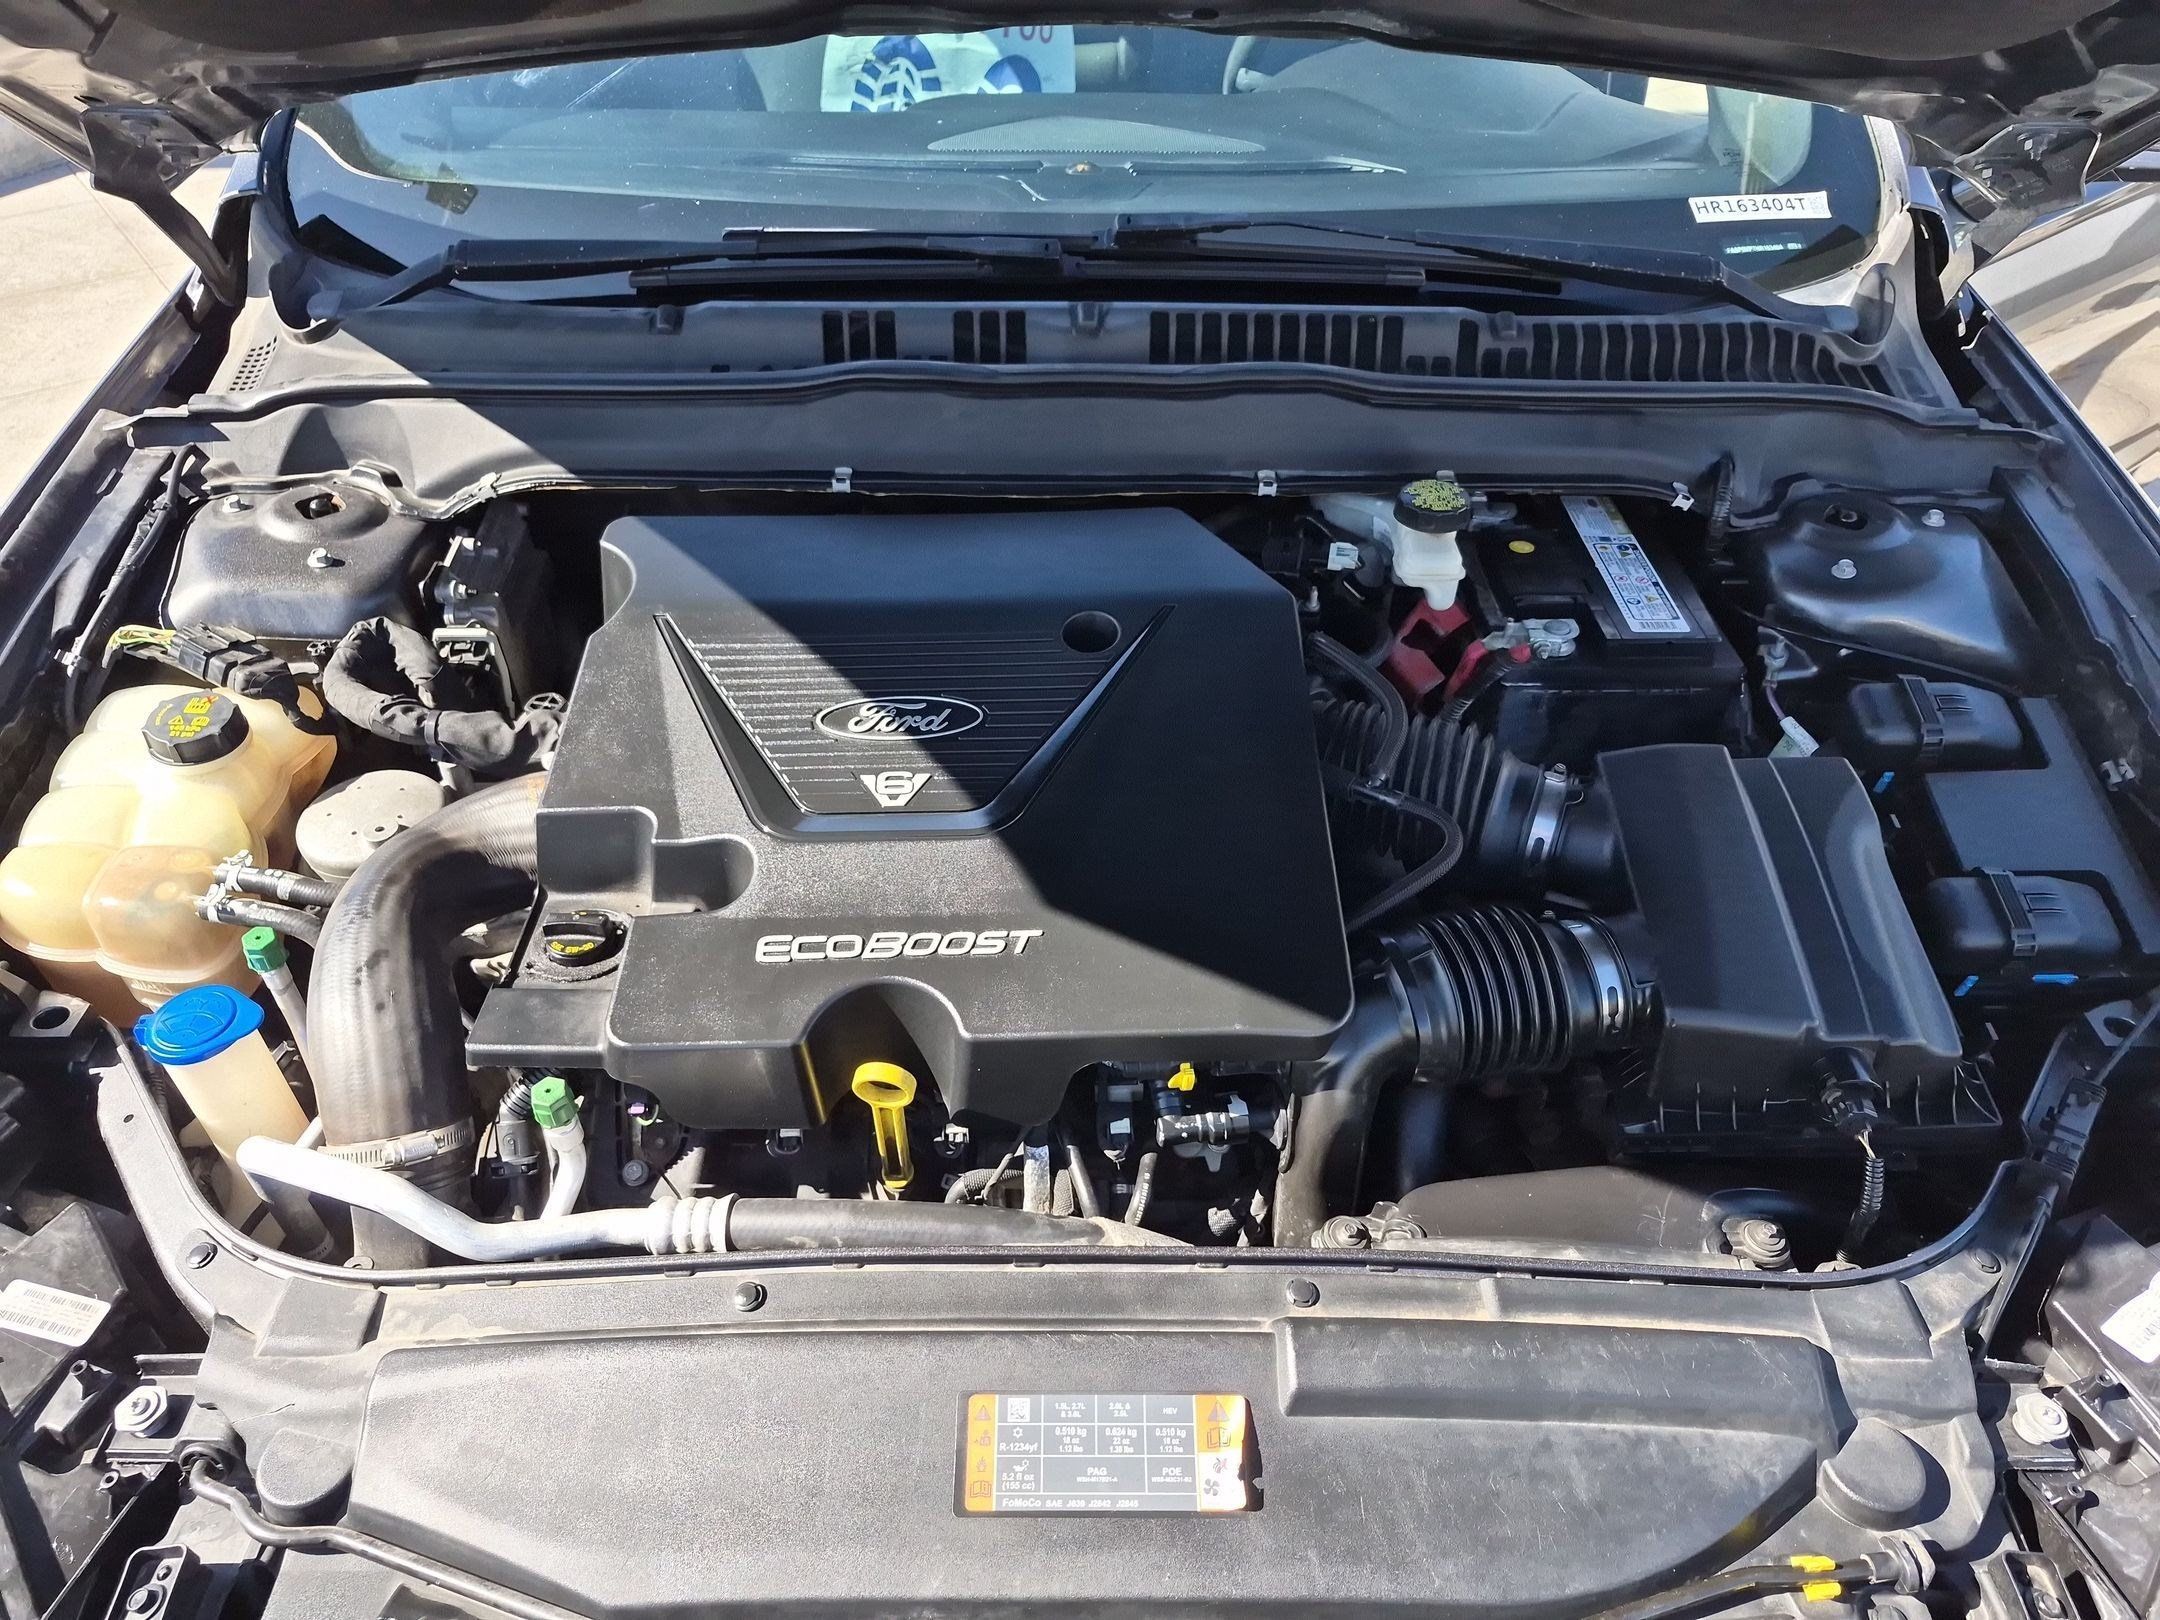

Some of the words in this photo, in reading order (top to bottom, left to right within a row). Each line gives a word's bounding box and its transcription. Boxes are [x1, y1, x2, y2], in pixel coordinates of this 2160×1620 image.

[1695, 197, 1806, 214] HR163404T
[848, 702, 951, 733] Ford
[755, 929, 1044, 963] ECOBOOST
[1162, 1407, 1178, 1415] HEV
[1055, 1427, 1075, 1436] 0.510
[1076, 1427, 1087, 1438] kg
[1127, 1427, 1138, 1438] kg
[1155, 1427, 1175, 1436] 0.510
[1176, 1427, 1187, 1438] kg
[999, 1442, 1038, 1454] R-1234yf
[1073, 1445, 1084, 1453] lbs
[1124, 1445, 1134, 1453] lbs
[1173, 1445, 1184, 1453] lbs
[1002, 1473, 1015, 1481] 5.2
[1016, 1472, 1023, 1481] fl
[1087, 1467, 1107, 1476] PAG
[1162, 1467, 1183, 1476] POE
[1002, 1481, 1020, 1491] (155
[1021, 1481, 1036, 1491] cc)
[1002, 1498, 1042, 1508] FoMoCo
[1045, 1499, 1063, 1508] SAE
